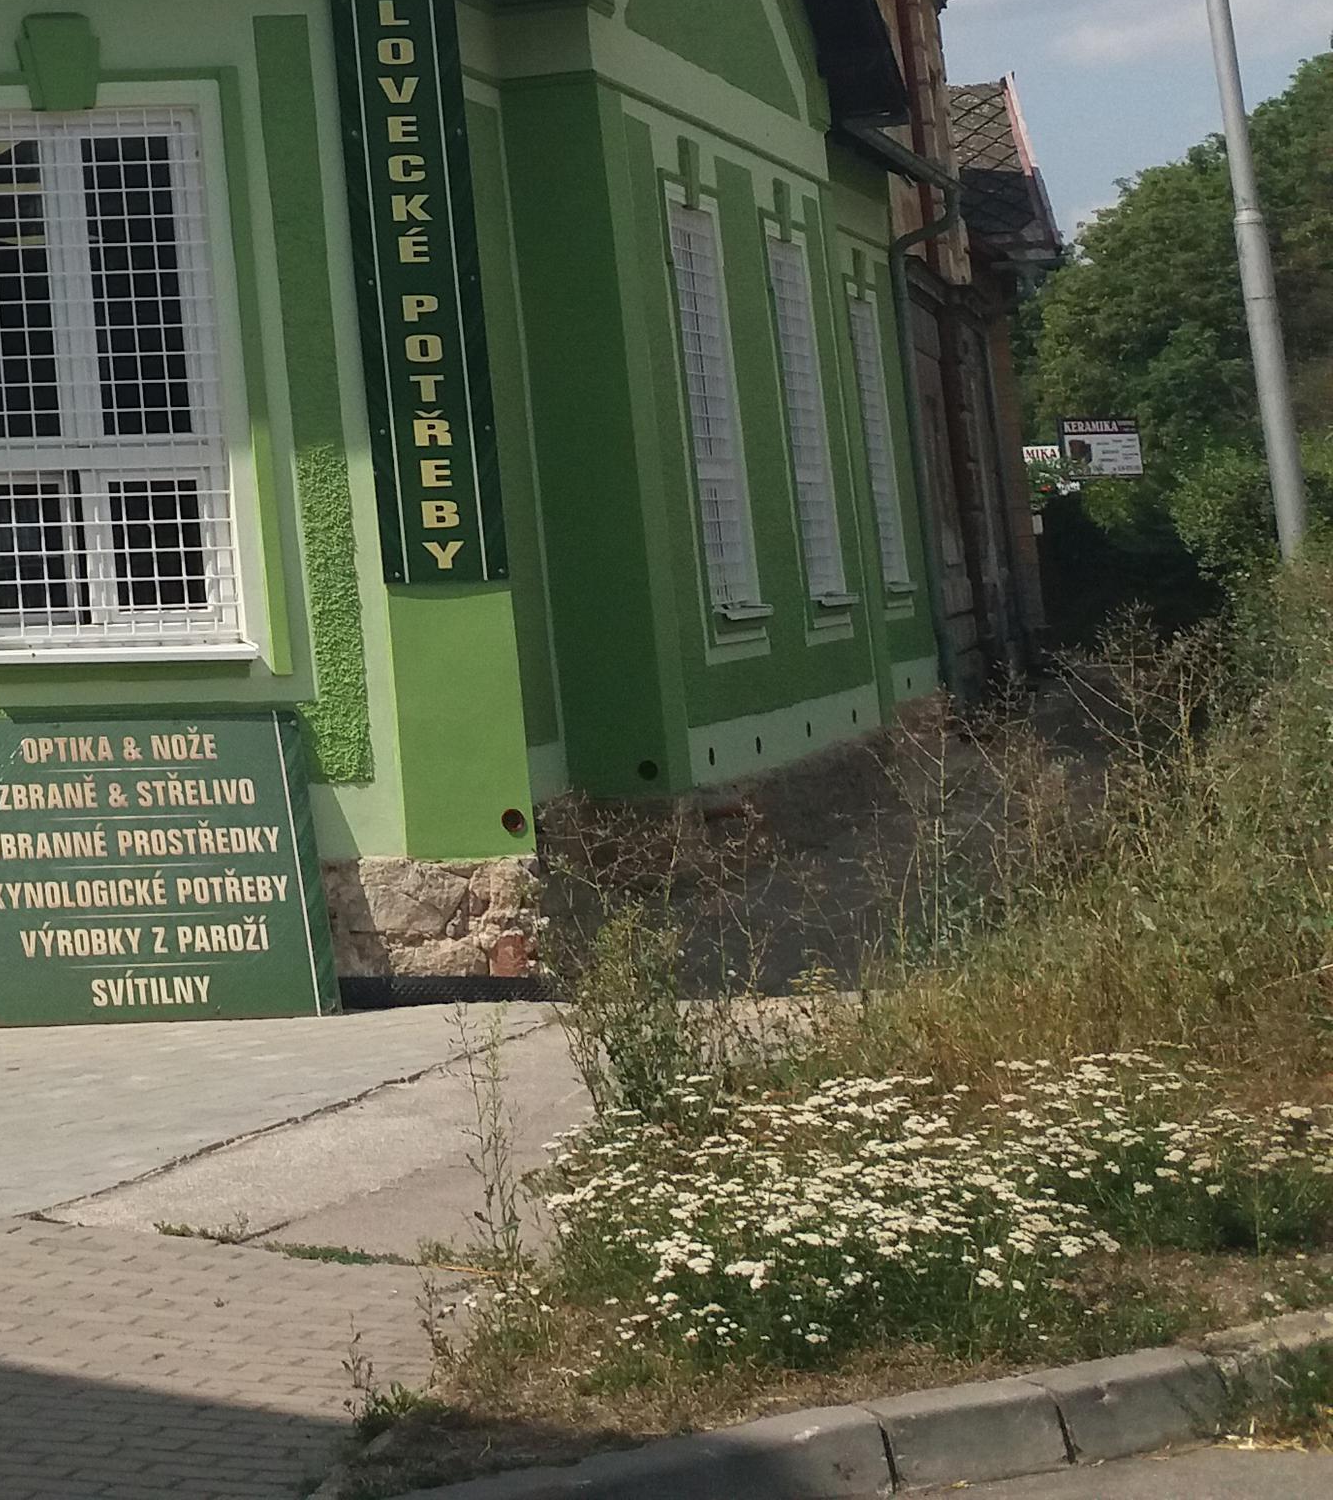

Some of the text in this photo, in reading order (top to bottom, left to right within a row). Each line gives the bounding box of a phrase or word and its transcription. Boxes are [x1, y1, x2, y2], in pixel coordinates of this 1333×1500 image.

[378, 0, 465, 570] LOVECKÉ POTŘEBY
[1063, 420, 1119, 433] KERAMIKA
[21, 726, 218, 764] OPTIKA & NOŽE
[108, 783, 129, 808] &
[136, 772, 256, 807] STŘELIVO
[117, 820, 280, 857] PROSTŘEDKY
[176, 868, 288, 905] POTŘEBY
[19, 915, 269, 958] VÝROBKY Z PAROŽÍ
[91, 970, 211, 1007] SVÍTILNY
